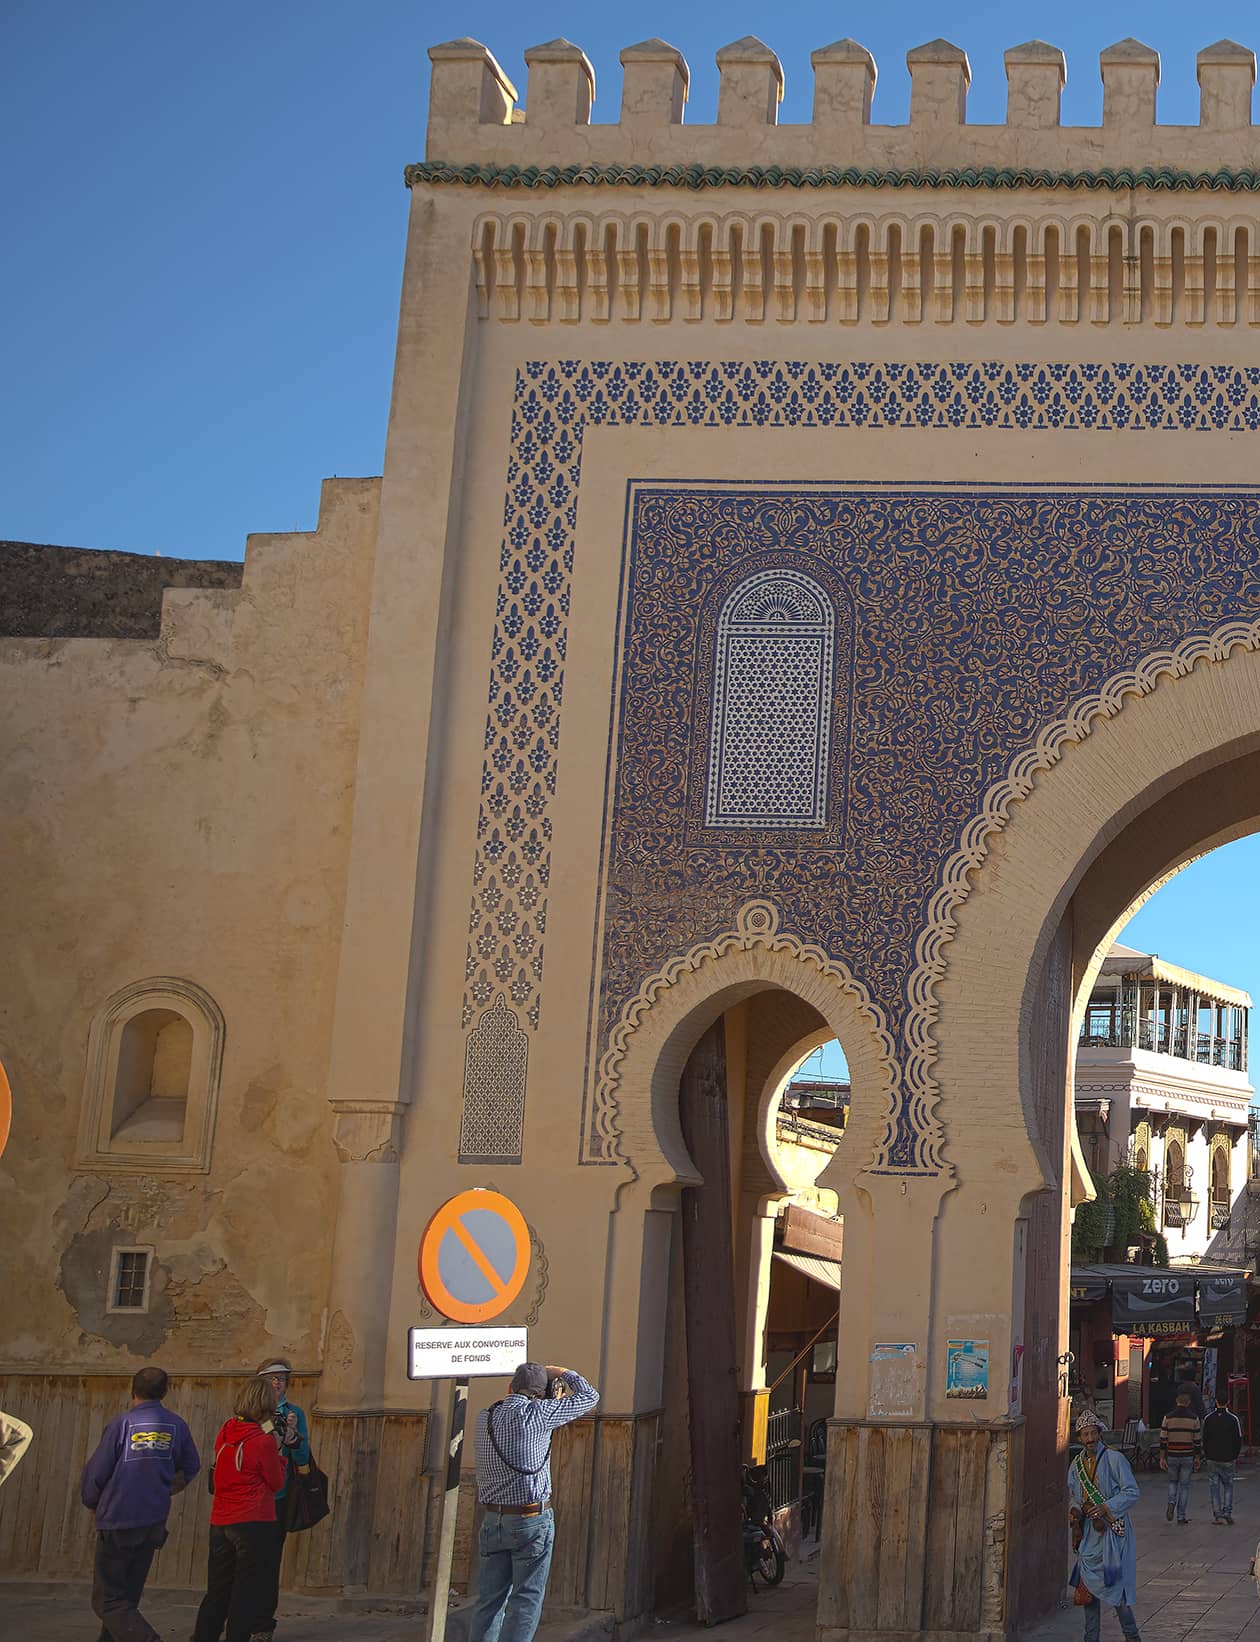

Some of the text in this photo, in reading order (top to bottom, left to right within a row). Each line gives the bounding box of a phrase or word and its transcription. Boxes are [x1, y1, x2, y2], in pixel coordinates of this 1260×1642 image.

[1142, 1278, 1180, 1295] zero
[1132, 1321, 1191, 1335] LA KASBAH
[415, 1340, 525, 1349] RESERVE AUX CONVOYEURS
[451, 1354, 491, 1363] DE FONDS
